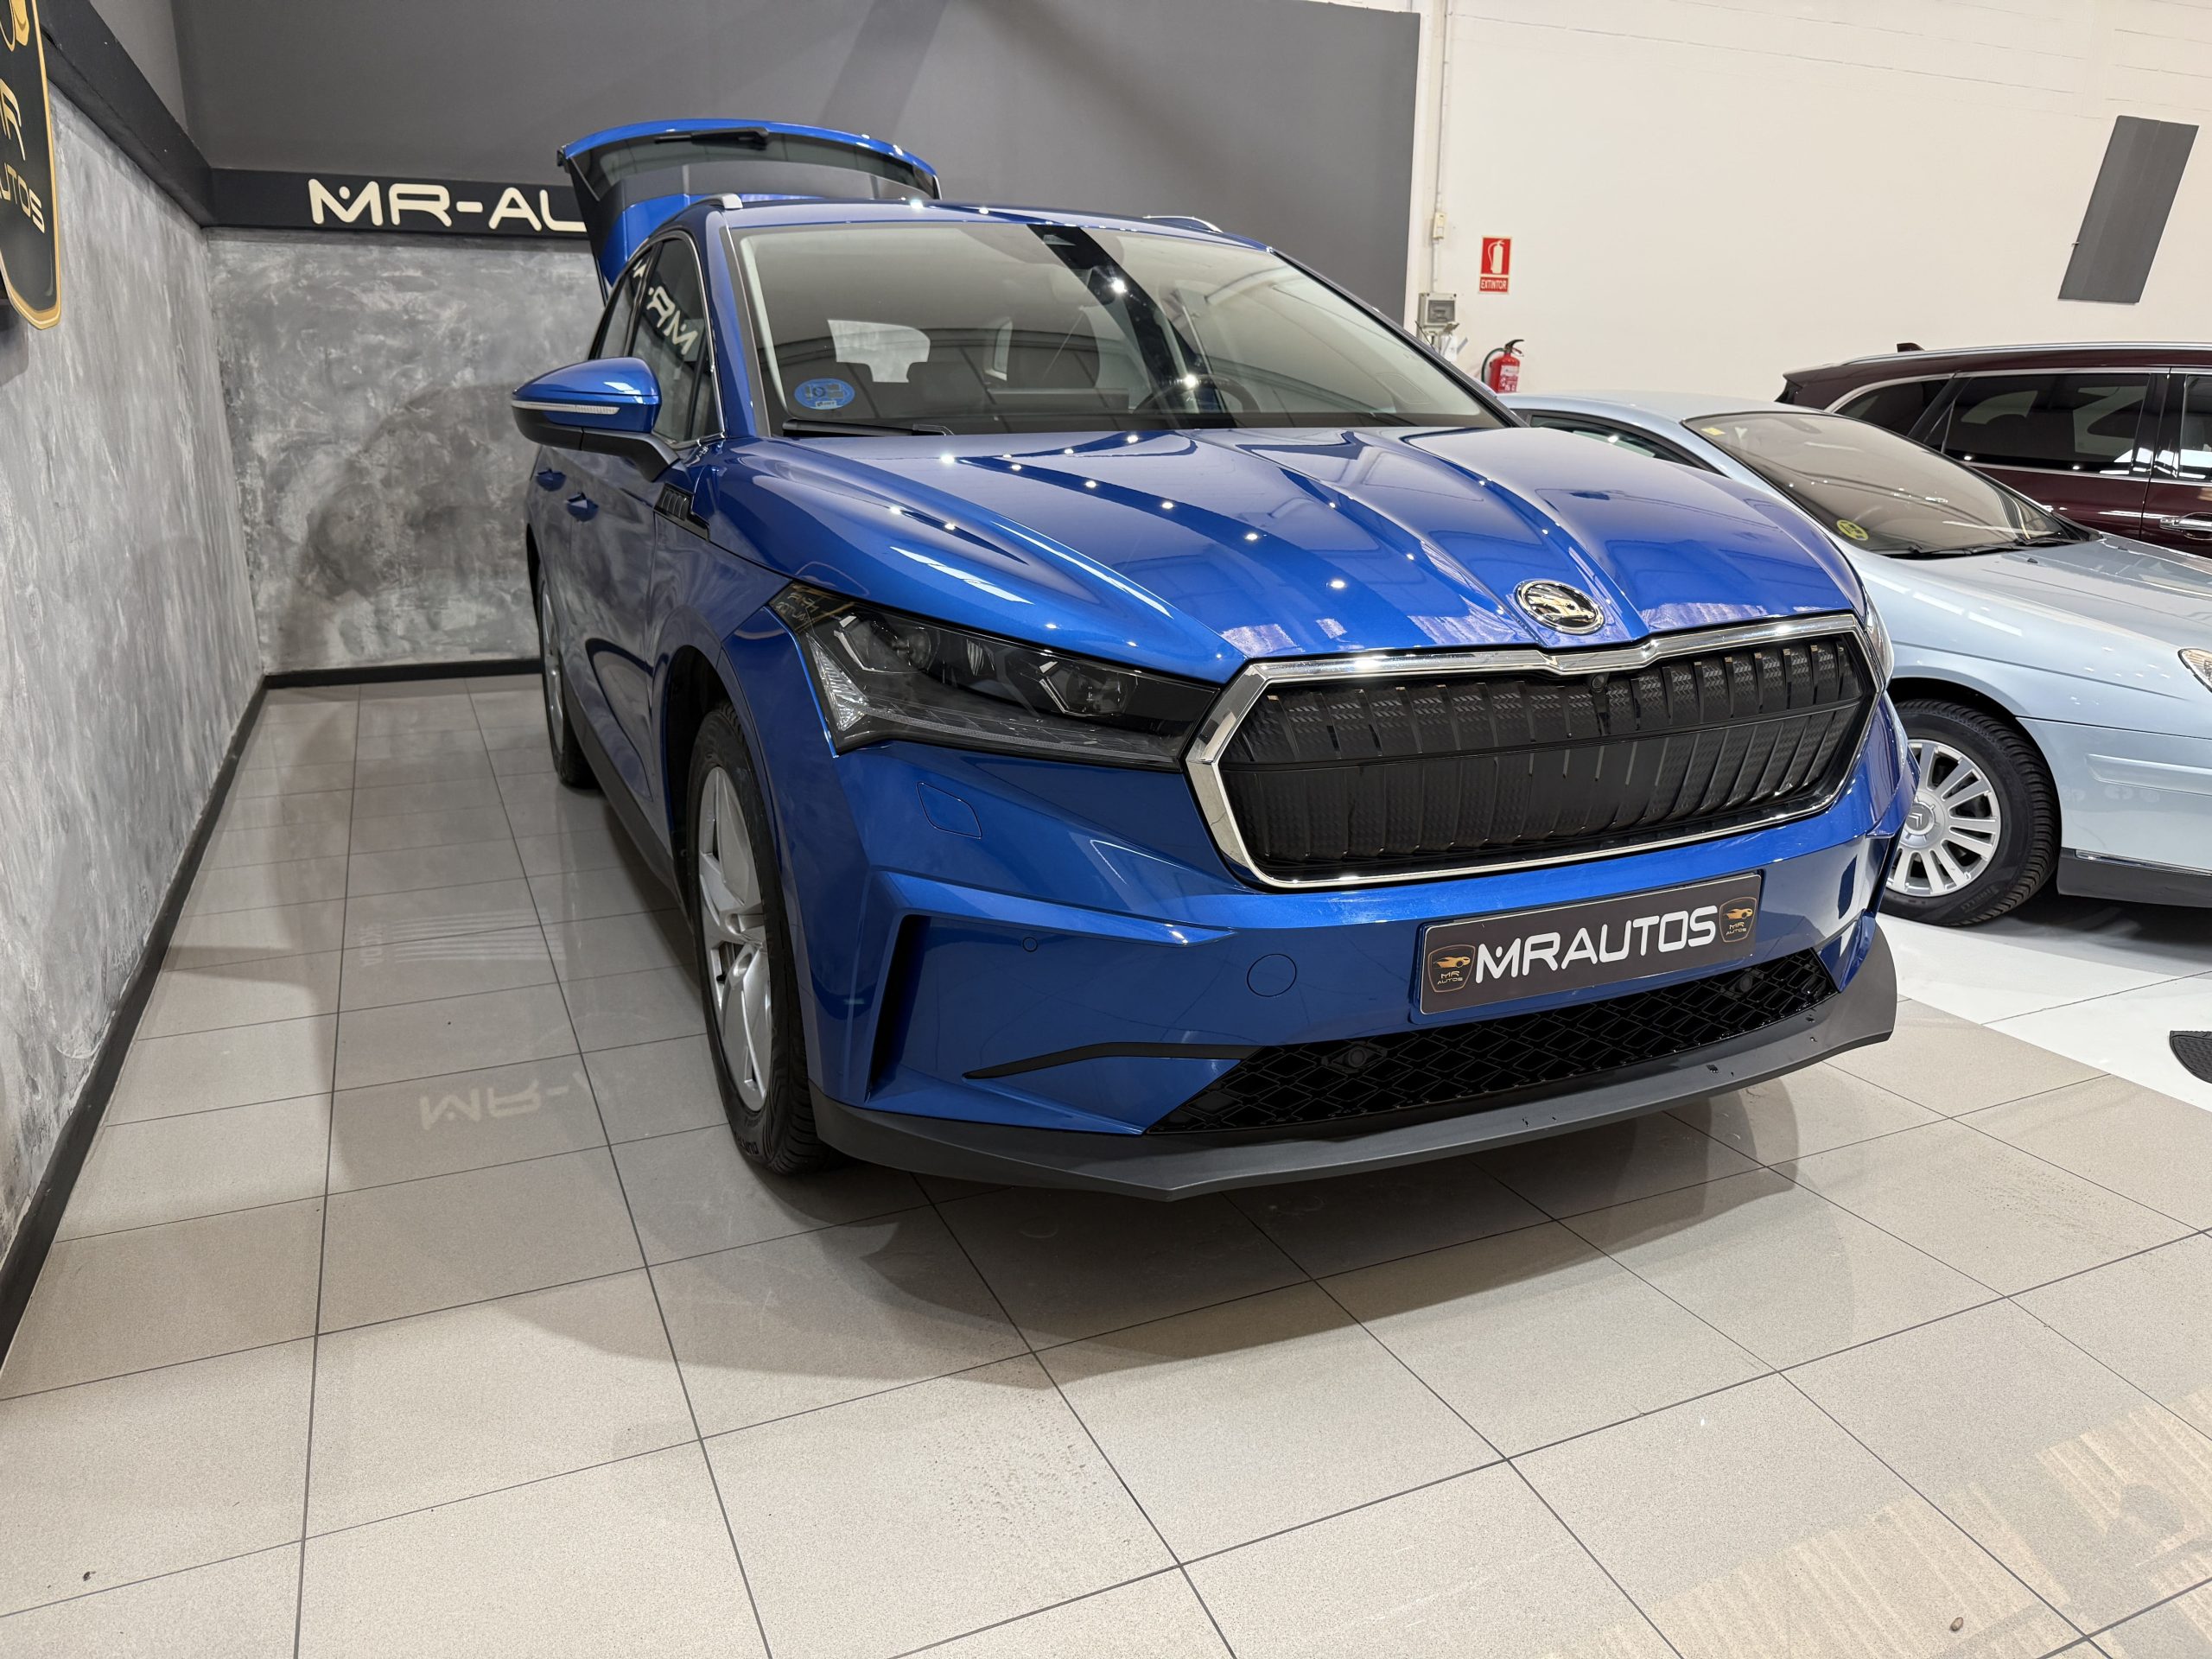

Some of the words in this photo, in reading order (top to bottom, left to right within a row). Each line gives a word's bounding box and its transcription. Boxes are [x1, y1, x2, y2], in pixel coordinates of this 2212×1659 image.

[0, 162, 45, 233] UTOS
[308, 178, 587, 232] MR-AU
[1480, 278, 1507, 290] EXTINTOR
[1437, 976, 1464, 985] AUTOS
